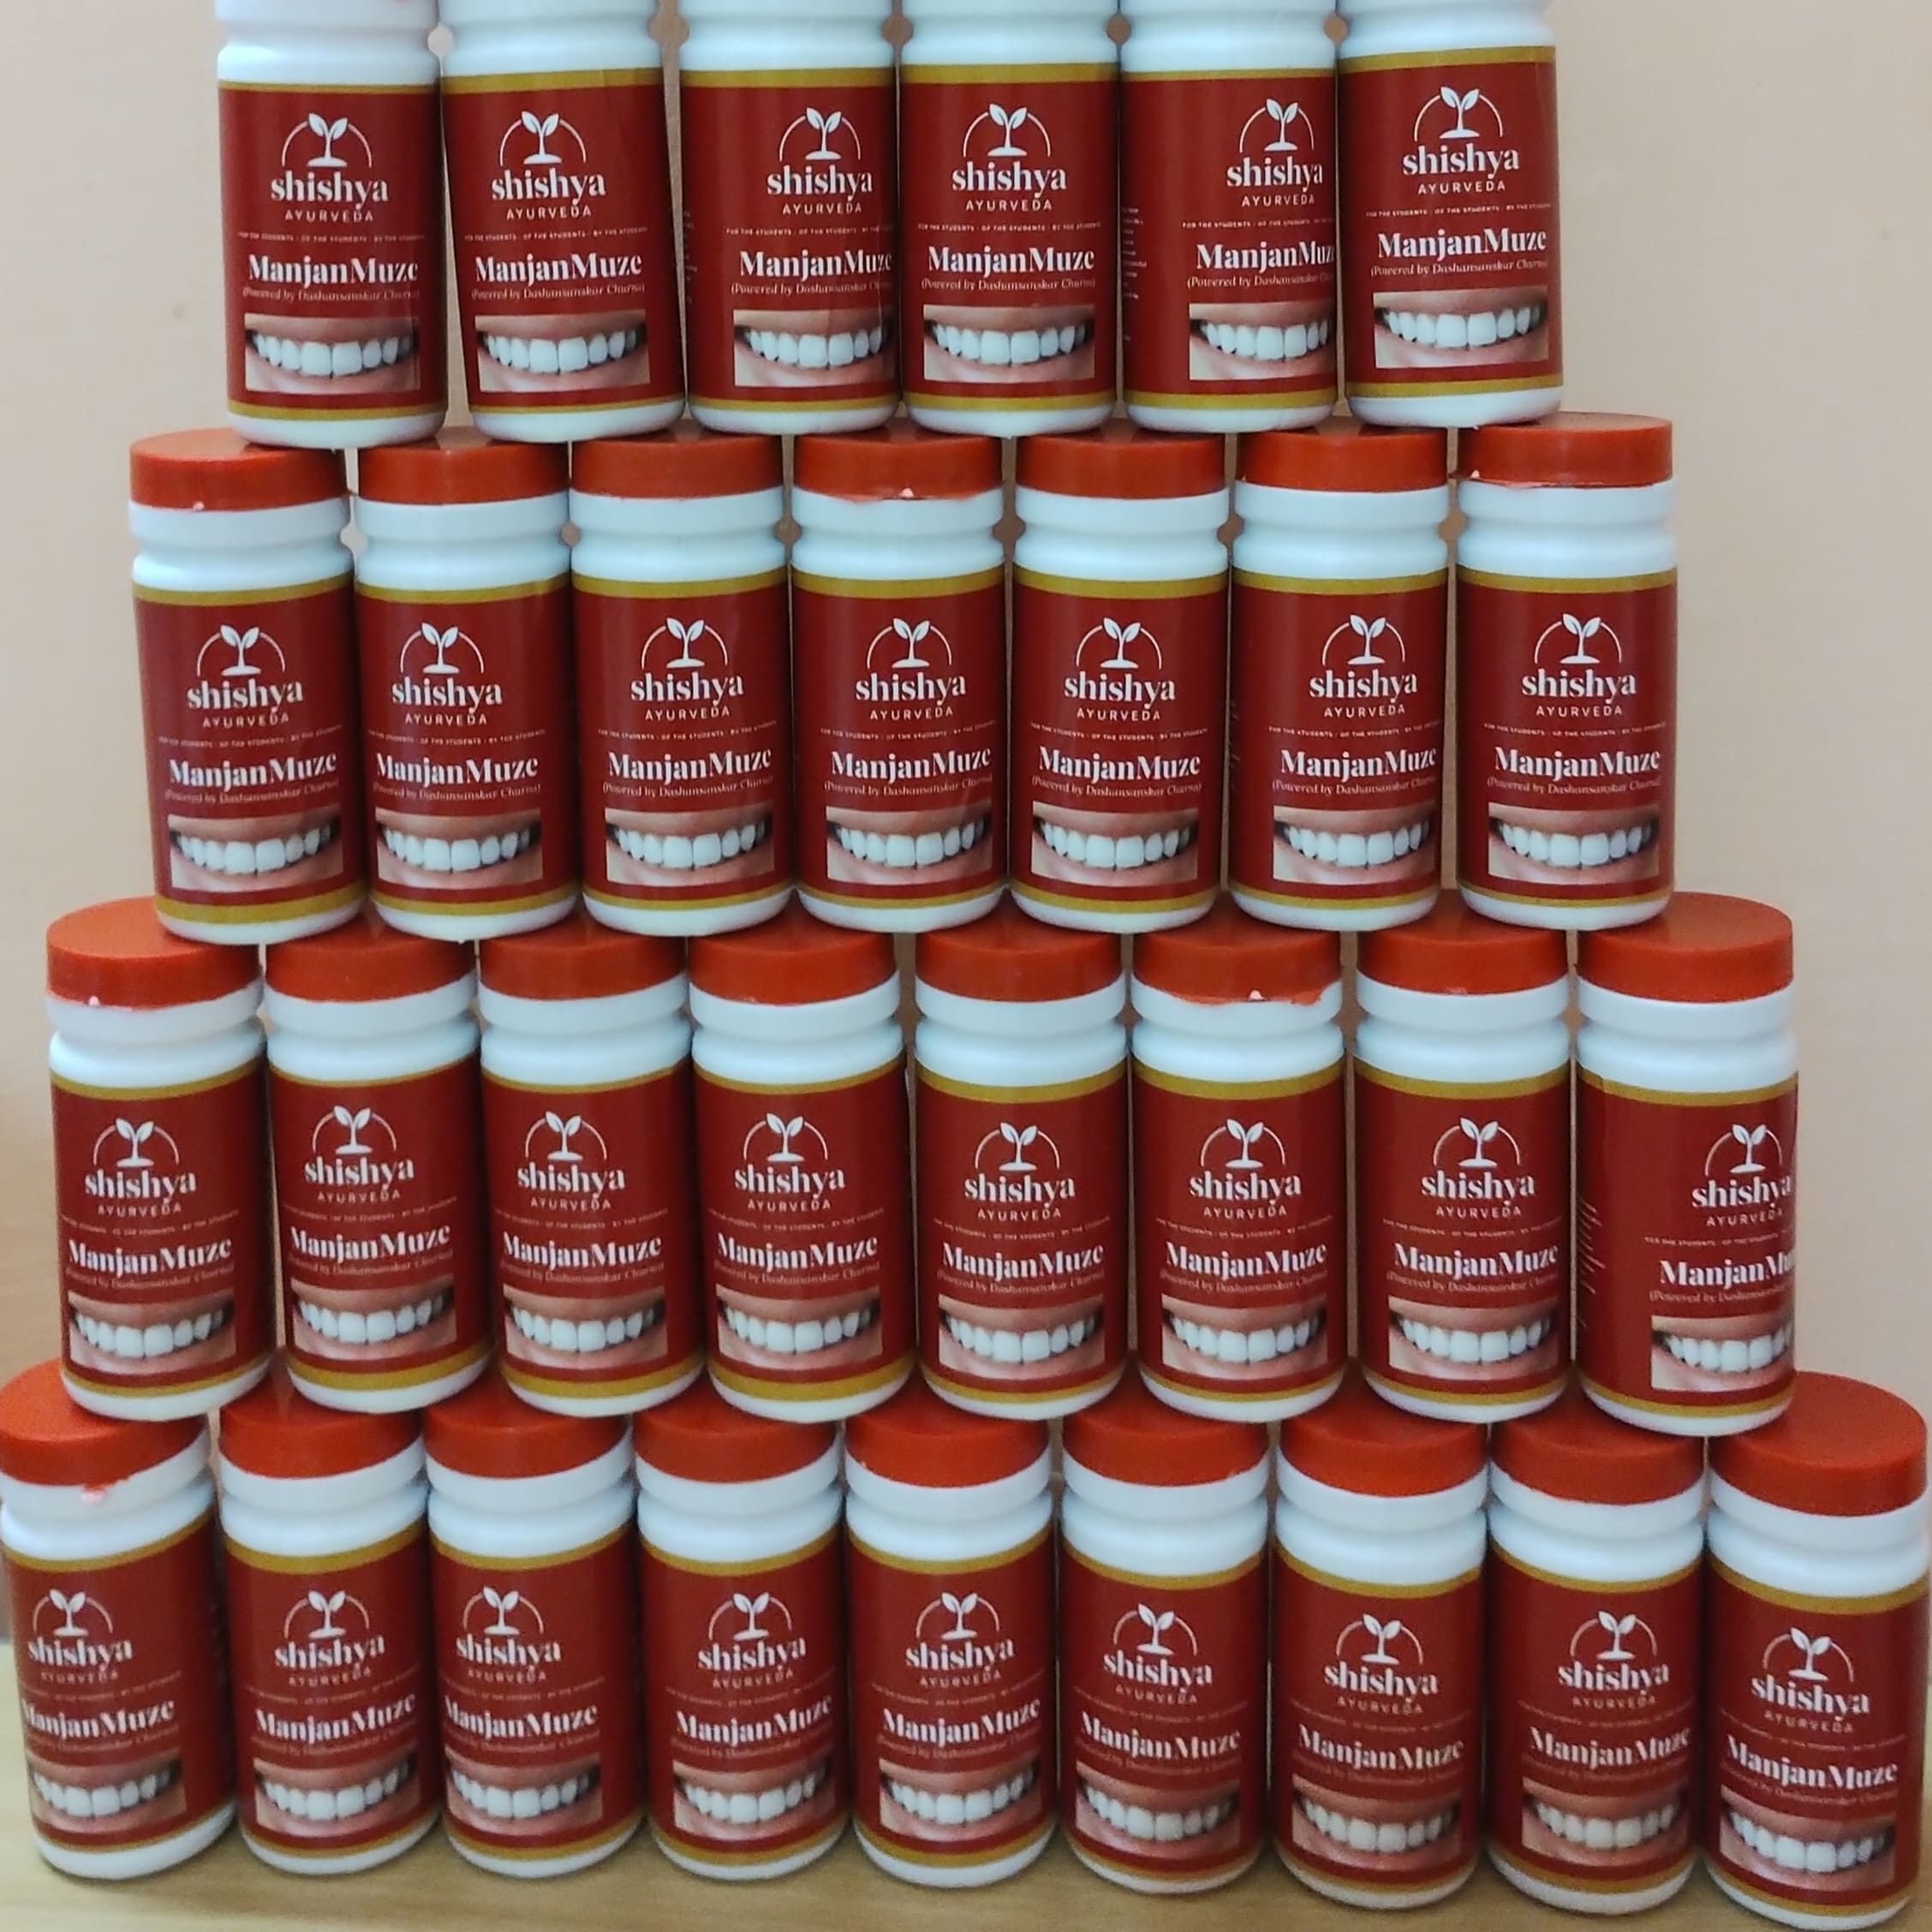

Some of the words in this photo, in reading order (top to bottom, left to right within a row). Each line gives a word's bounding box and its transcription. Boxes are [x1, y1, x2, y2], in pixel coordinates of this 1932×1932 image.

[1226, 156, 1322, 192] shishya
[1403, 141, 1519, 181] shishya
[271, 170, 389, 212] shishya
[492, 168, 606, 210] shishya
[767, 164, 873, 203] shishya
[952, 162, 1066, 200] shishya
[1417, 181, 1506, 194] AYURVEDA
[285, 209, 373, 222] AYURVEDA
[506, 206, 592, 220] AYURVEDA
[782, 203, 862, 215] AYURVEDA
[965, 198, 1052, 212] AYURVEDA
[1242, 194, 1315, 206] AYURVEDA
[928, 246, 1094, 278] ManjanMuze
[1378, 228, 1547, 260] ManjanMuze
[248, 255, 419, 289] ManjanMuze
[475, 252, 642, 286] ManjanMuze
[740, 249, 891, 279] ManjanMuze
[1187, 276, 1236, 288] (Powered
[1239, 276, 1251, 287] by
[1371, 265, 1413, 277] (Powered
[1417, 264, 1429, 276] by
[731, 283, 777, 295] (Powered
[781, 283, 792, 295] by
[921, 278, 960, 289] (Powered
[963, 279, 975, 290] by
[188, 678, 303, 717] shishya
[392, 677, 503, 713] shishya
[630, 672, 743, 706] shishya
[856, 672, 966, 707] shishya
[1064, 671, 1176, 709] shishya
[1309, 669, 1417, 704] shishya
[1522, 668, 1637, 704] shishya
[202, 713, 289, 728] AYURVEDA
[404, 713, 487, 725] AYURVEDA
[645, 707, 730, 720] AYURVEDA
[870, 707, 953, 720] AYURVEDA
[1076, 708, 1160, 720] AYURVEDA
[1323, 705, 1405, 718] AYURVEDA
[1536, 706, 1622, 717] AYURVEDA
[169, 753, 337, 791] ManjanMuze
[377, 753, 538, 789] ManjanMuze
[609, 748, 771, 784] ManjanMuze
[832, 748, 991, 784] ManjanMuze
[1039, 746, 1201, 784] ManjanMuze
[1281, 746, 1436, 782] ManjanMuze
[1494, 746, 1661, 781] ManjanMuze
[645, 786, 655, 798] by
[868, 784, 879, 796] by
[1032, 776, 1070, 792] (Powered
[1071, 781, 1082, 795] by
[1272, 779, 1318, 793] (Powered
[1321, 783, 1332, 796] by
[86, 1170, 196, 1206] shishya
[305, 1156, 414, 1193] shishya
[517, 1162, 625, 1197] shishya
[735, 1163, 845, 1198] shishya
[964, 1173, 1075, 1208] shishya
[1190, 1171, 1302, 1205] shishya
[1421, 1171, 1535, 1207] shishya
[1691, 1173, 1792, 1210] shishya
[98, 1203, 182, 1216] AYURVEDA
[318, 1189, 401, 1203] AYURVEDA
[531, 1197, 611, 1211] AYURVEDA
[747, 1199, 831, 1212] AYURVEDA
[1203, 1205, 1286, 1219] AYURVEDA
[1436, 1205, 1522, 1219] AYURVEDA
[978, 1208, 1061, 1221] AYURVEDA
[1706, 1208, 1783, 1227] AYURVEDA
[69, 1237, 231, 1278] ManjanMuze
[291, 1224, 450, 1262] ManjanMuze
[504, 1231, 662, 1270] ManjanMuze
[719, 1233, 878, 1271] ManjanMuze
[943, 1242, 1104, 1280] ManjanMuze
[1166, 1241, 1327, 1279] ManjanMuze
[1394, 1243, 1559, 1279] ManjanMuze
[28, 1637, 134, 1673] shishya
[275, 1634, 385, 1673] shishya
[456, 1633, 562, 1673] shishya
[698, 1637, 807, 1674] shishya
[905, 1637, 1015, 1673] shishya
[1104, 1649, 1213, 1693] shishya
[1324, 1661, 1439, 1702] shishya
[1558, 1661, 1670, 1697] shishya
[1750, 1675, 1870, 1720] shishya
[22, 1697, 174, 1740] ManjanMuze
[256, 1693, 415, 1744] ManjanMuze
[444, 1695, 598, 1740] ManjanMuze
[677, 1696, 832, 1746] ManjanMuze
[883, 1697, 1041, 1747] ManjanMuze
[1082, 1711, 1241, 1761] ManjanMuze
[1298, 1723, 1464, 1770] ManjanMuze
[1530, 1725, 1690, 1770] ManjanMuze
[1726, 1733, 1898, 1790] ManjanMuze
